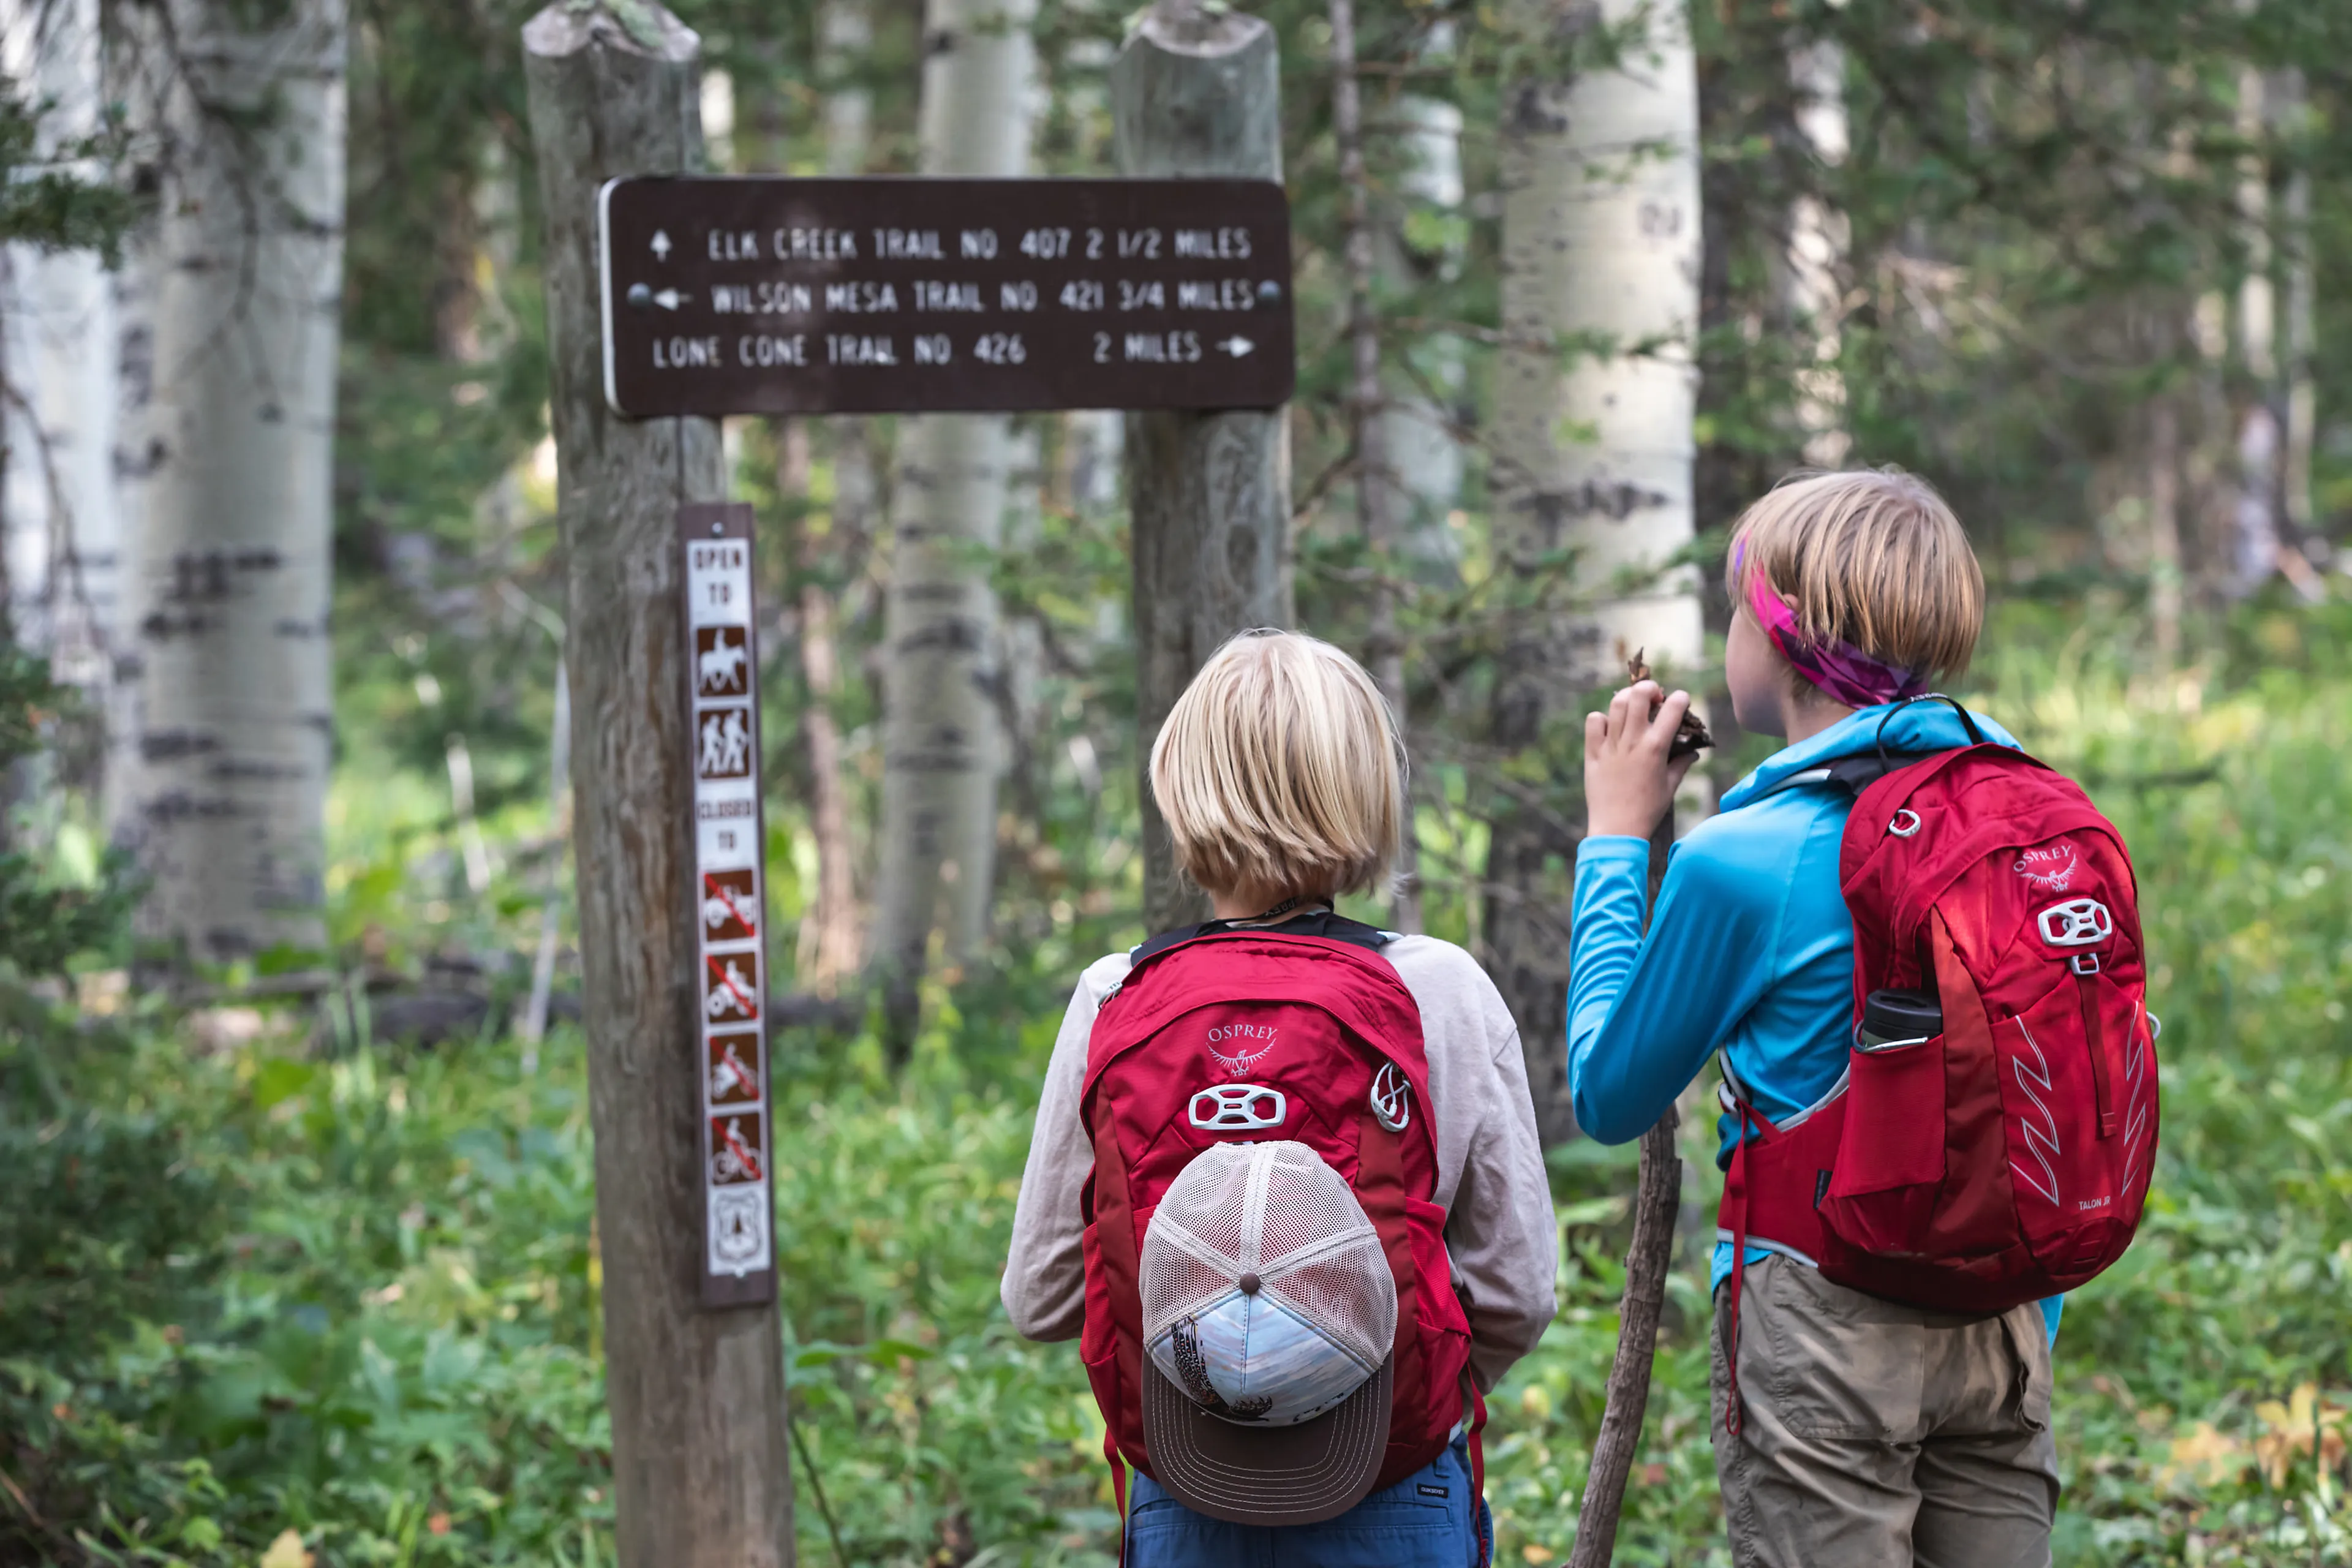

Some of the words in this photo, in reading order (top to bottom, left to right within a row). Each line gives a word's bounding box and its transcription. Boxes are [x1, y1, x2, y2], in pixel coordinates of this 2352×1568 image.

[708, 230, 759, 260] ELK
[773, 228, 858, 260] CREEK
[873, 228, 945, 260] TRAIL
[1020, 228, 1071, 260] 407
[1086, 228, 1103, 260] 2
[1118, 228, 1162, 259] 1/2
[1175, 227, 1251, 259] MILES
[711, 282, 812, 314] WILSON
[825, 282, 898, 313] MESA
[913, 281, 984, 312] TRAIL
[1059, 280, 1104, 311] 421
[1119, 280, 1165, 311] 3/4
[1177, 279, 1255, 311] MILES
[653, 336, 722, 368] LONE
[739, 335, 807, 367] CONE
[826, 335, 897, 366] TRAIL
[973, 333, 1027, 364] 426
[1093, 331, 1111, 364] 2
[1124, 330, 1202, 363] MILES
[694, 548, 742, 570] OPEN
[708, 582, 732, 605] TO
[2013, 845, 2071, 872] OSPREY
[1208, 1024, 1278, 1042] OSPREY
[2078, 1197, 2101, 1211] TALON
[2103, 1196, 2111, 1206] JR
